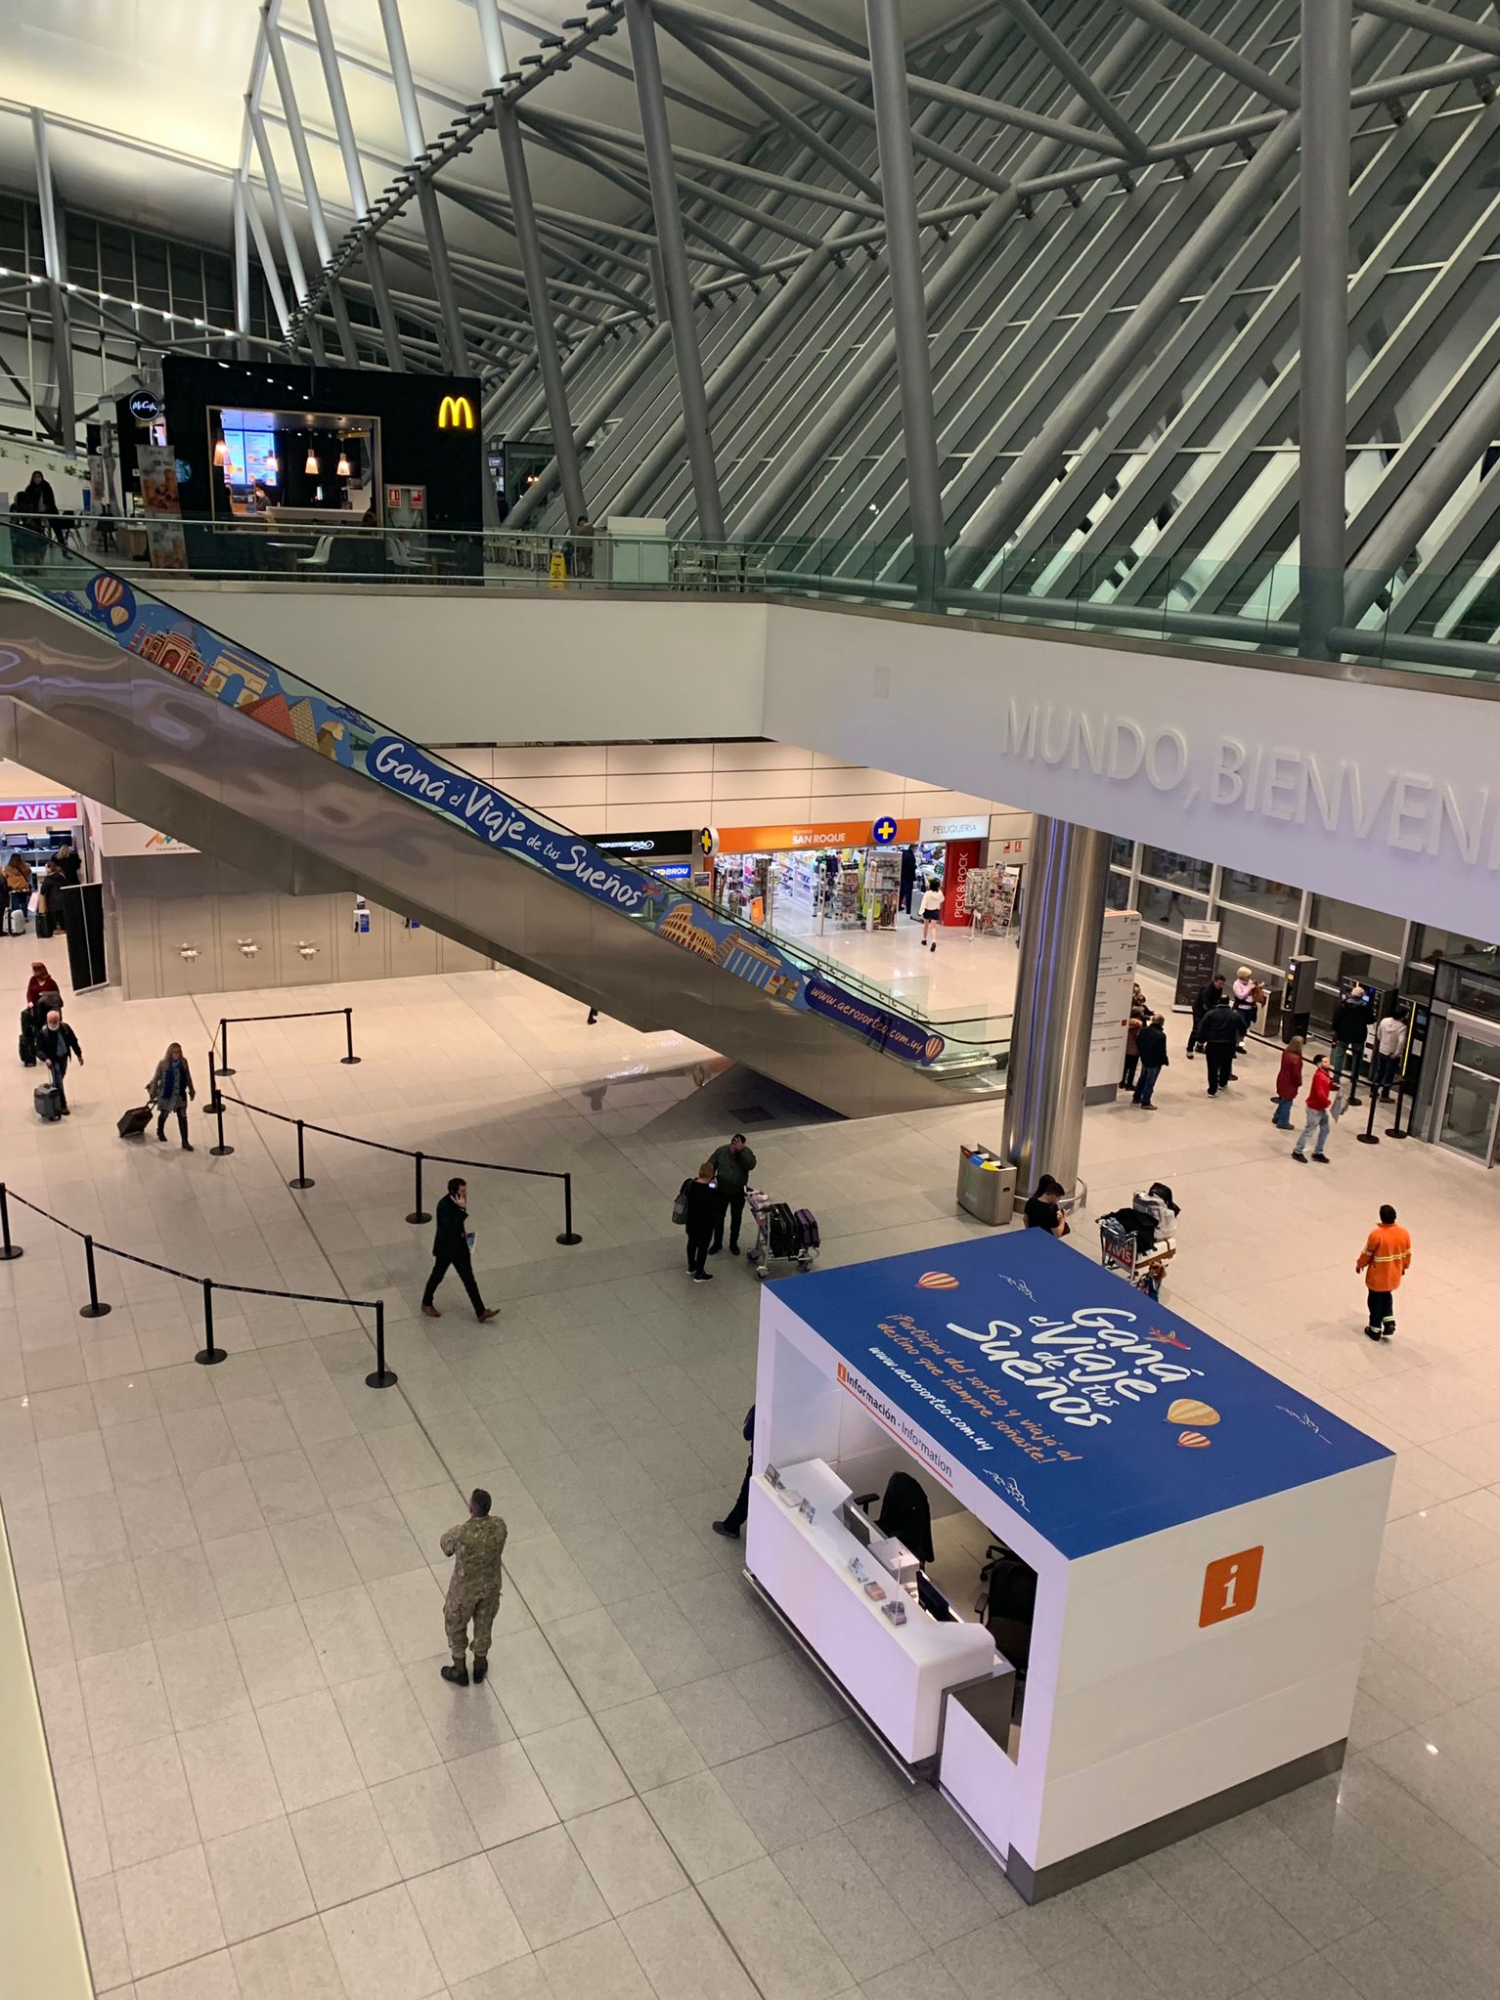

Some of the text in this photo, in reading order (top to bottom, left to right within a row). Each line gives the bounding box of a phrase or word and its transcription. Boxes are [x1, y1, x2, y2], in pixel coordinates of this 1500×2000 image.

[1000, 697, 1199, 812] MUNDO,
[13, 804, 59, 820] AVIS
[375, 743, 642, 906] Ganá el Viaje de tus Sueños
[792, 833, 846, 845] SAN ROQUE
[933, 823, 977, 835] PELUQUERÍA
[954, 894, 967, 918] PICK
[957, 852, 969, 883] POCK
[810, 987, 924, 1054] www.aerosorteo.com.uy
[946, 1319, 1113, 1427] Sueños
[1028, 1315, 1157, 1402] el Viaje
[1033, 1352, 1120, 1407] de tus
[1071, 1307, 1205, 1383] Ganá
[846, 1371, 953, 1478] Información Information
[868, 1346, 994, 1452] www.aerosorteo.com.uy
[877, 1323, 1057, 1465] destino que siempre soñaste!
[944, 1357, 976, 1375] del
[965, 1374, 1008, 1407] sorteo
[1005, 1408, 1022, 1419] y
[1020, 1418, 1064, 1448] viajá
[1056, 1450, 1084, 1462] al
